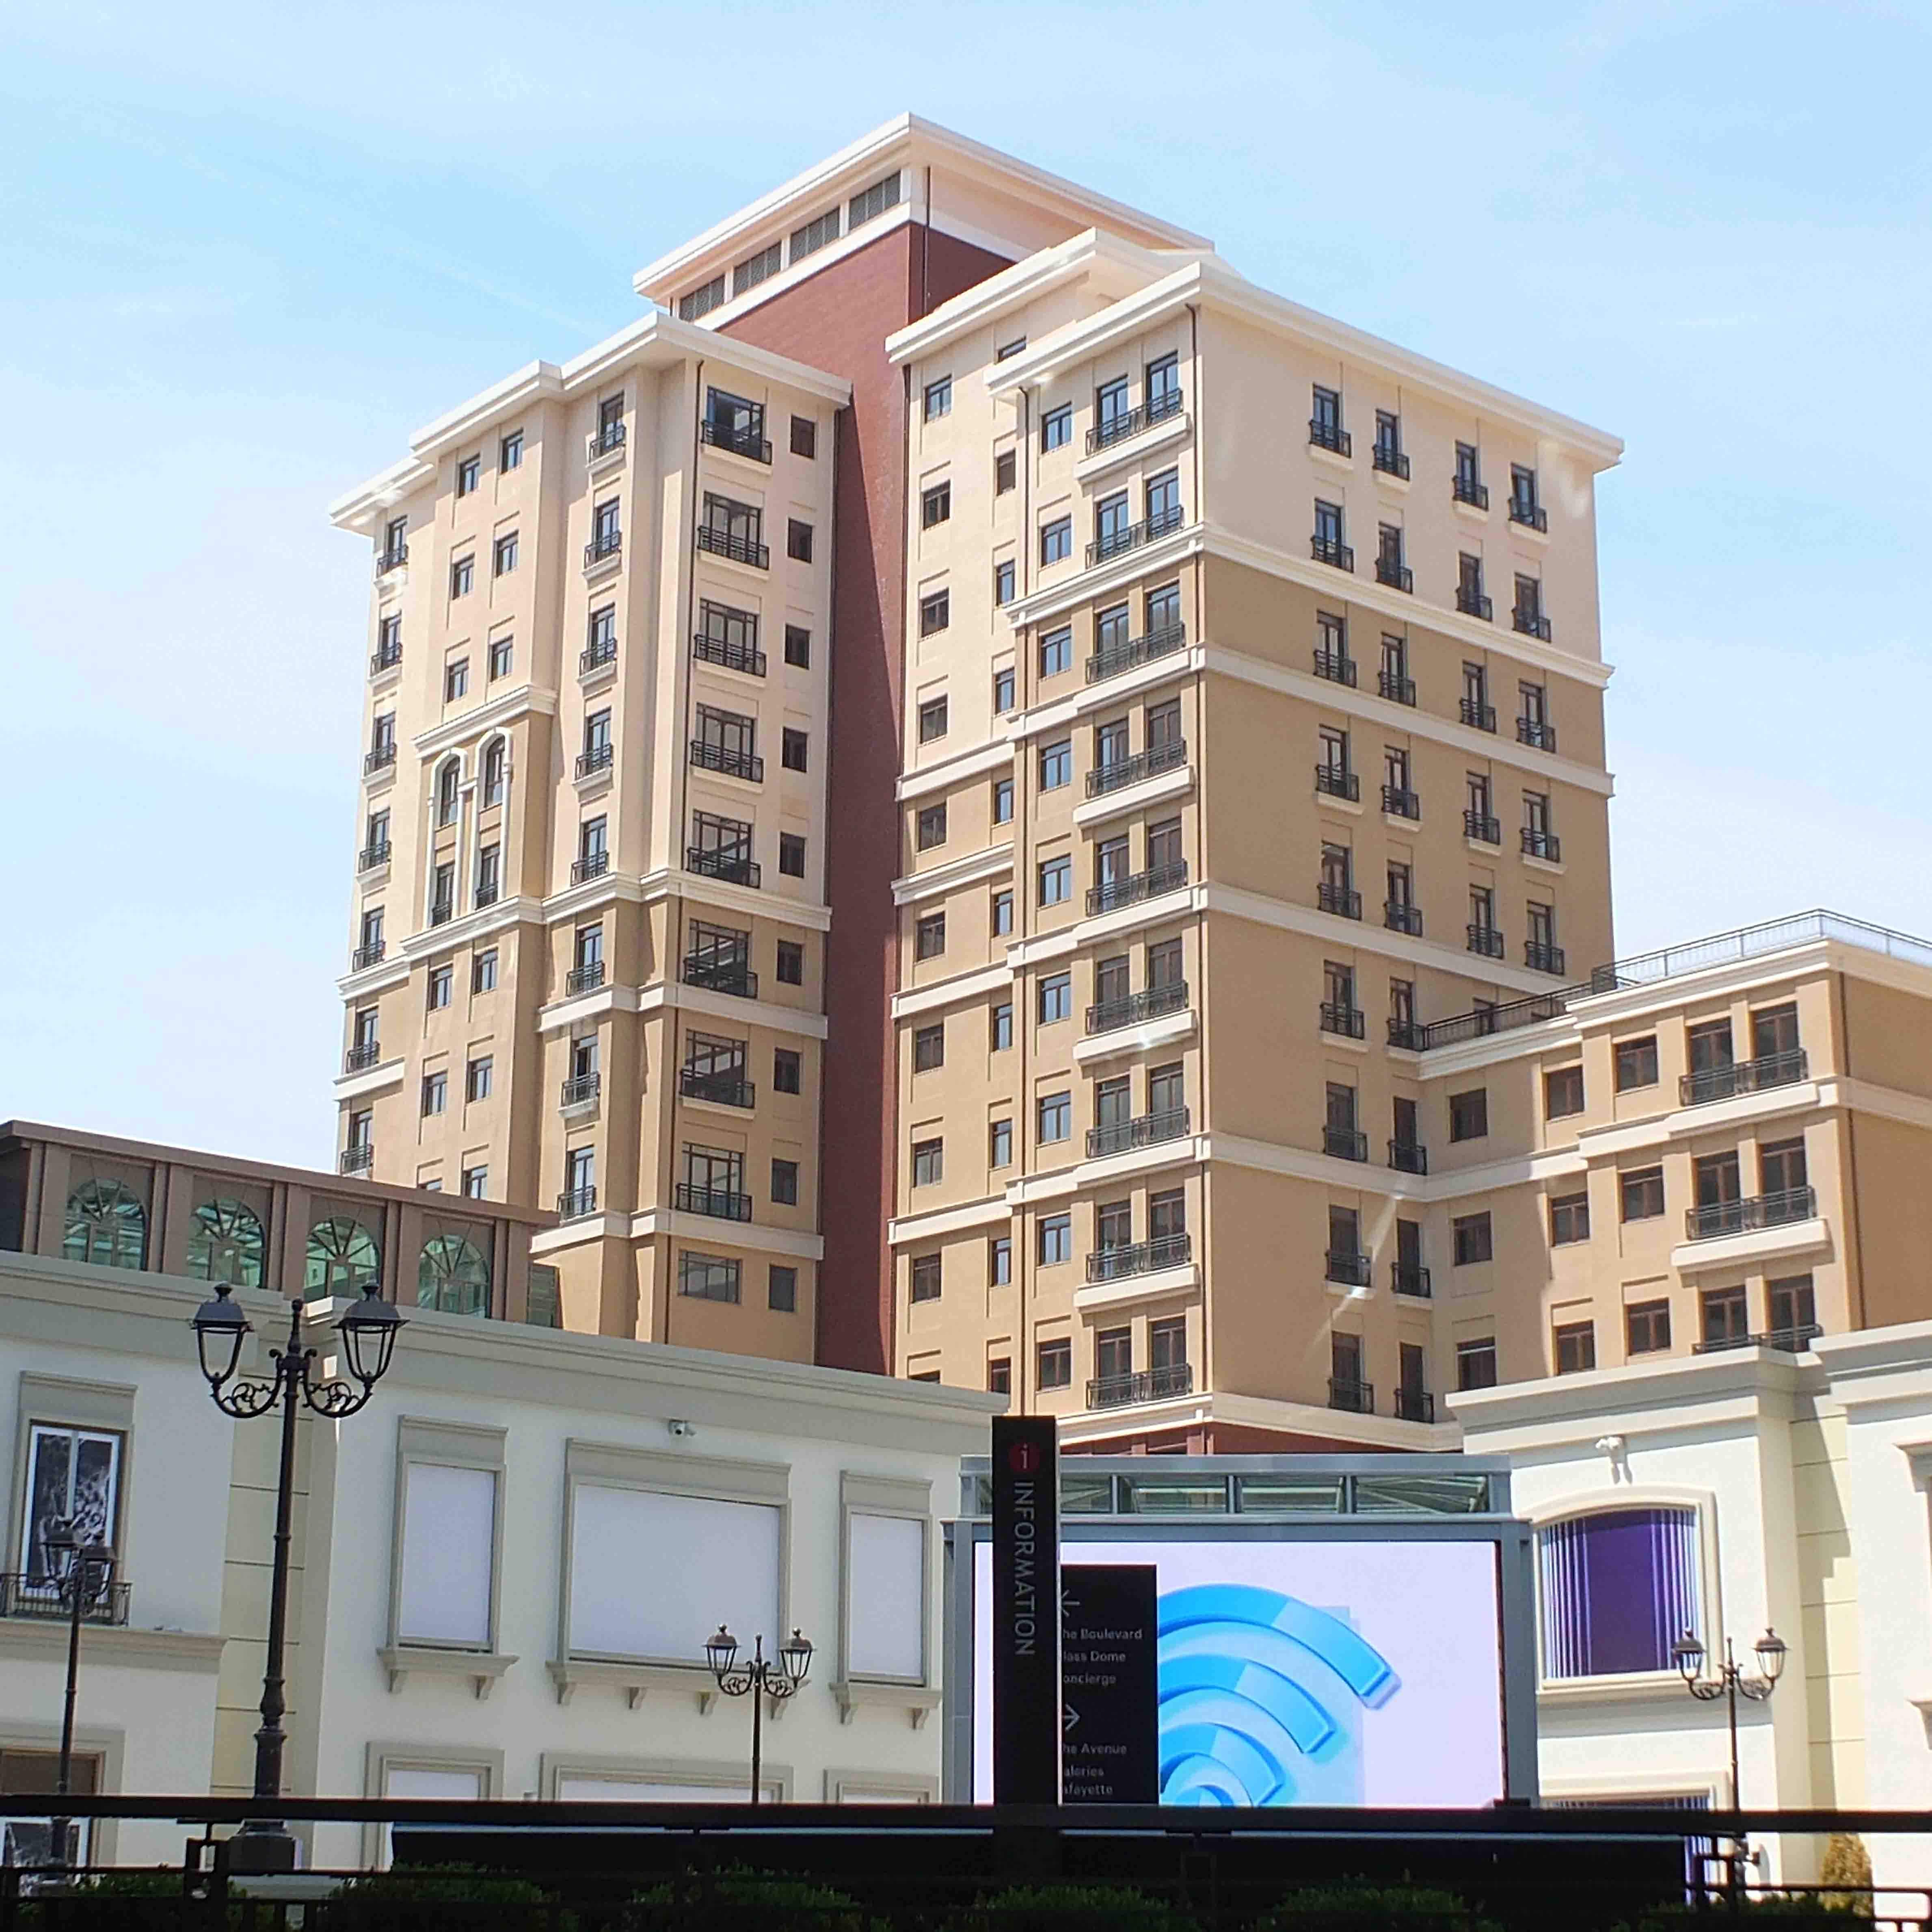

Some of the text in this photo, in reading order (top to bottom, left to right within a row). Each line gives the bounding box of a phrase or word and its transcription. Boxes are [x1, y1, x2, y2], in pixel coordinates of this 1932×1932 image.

[1014, 1481, 1035, 1655] INFORMATION
[1063, 1628, 1143, 1640] he Boulevard
[1063, 1651, 1126, 1662] lass Dome
[1063, 1673, 1116, 1685] oncierge
[1062, 1743, 1127, 1754] he Avenue
[1064, 1765, 1104, 1776] aleries
